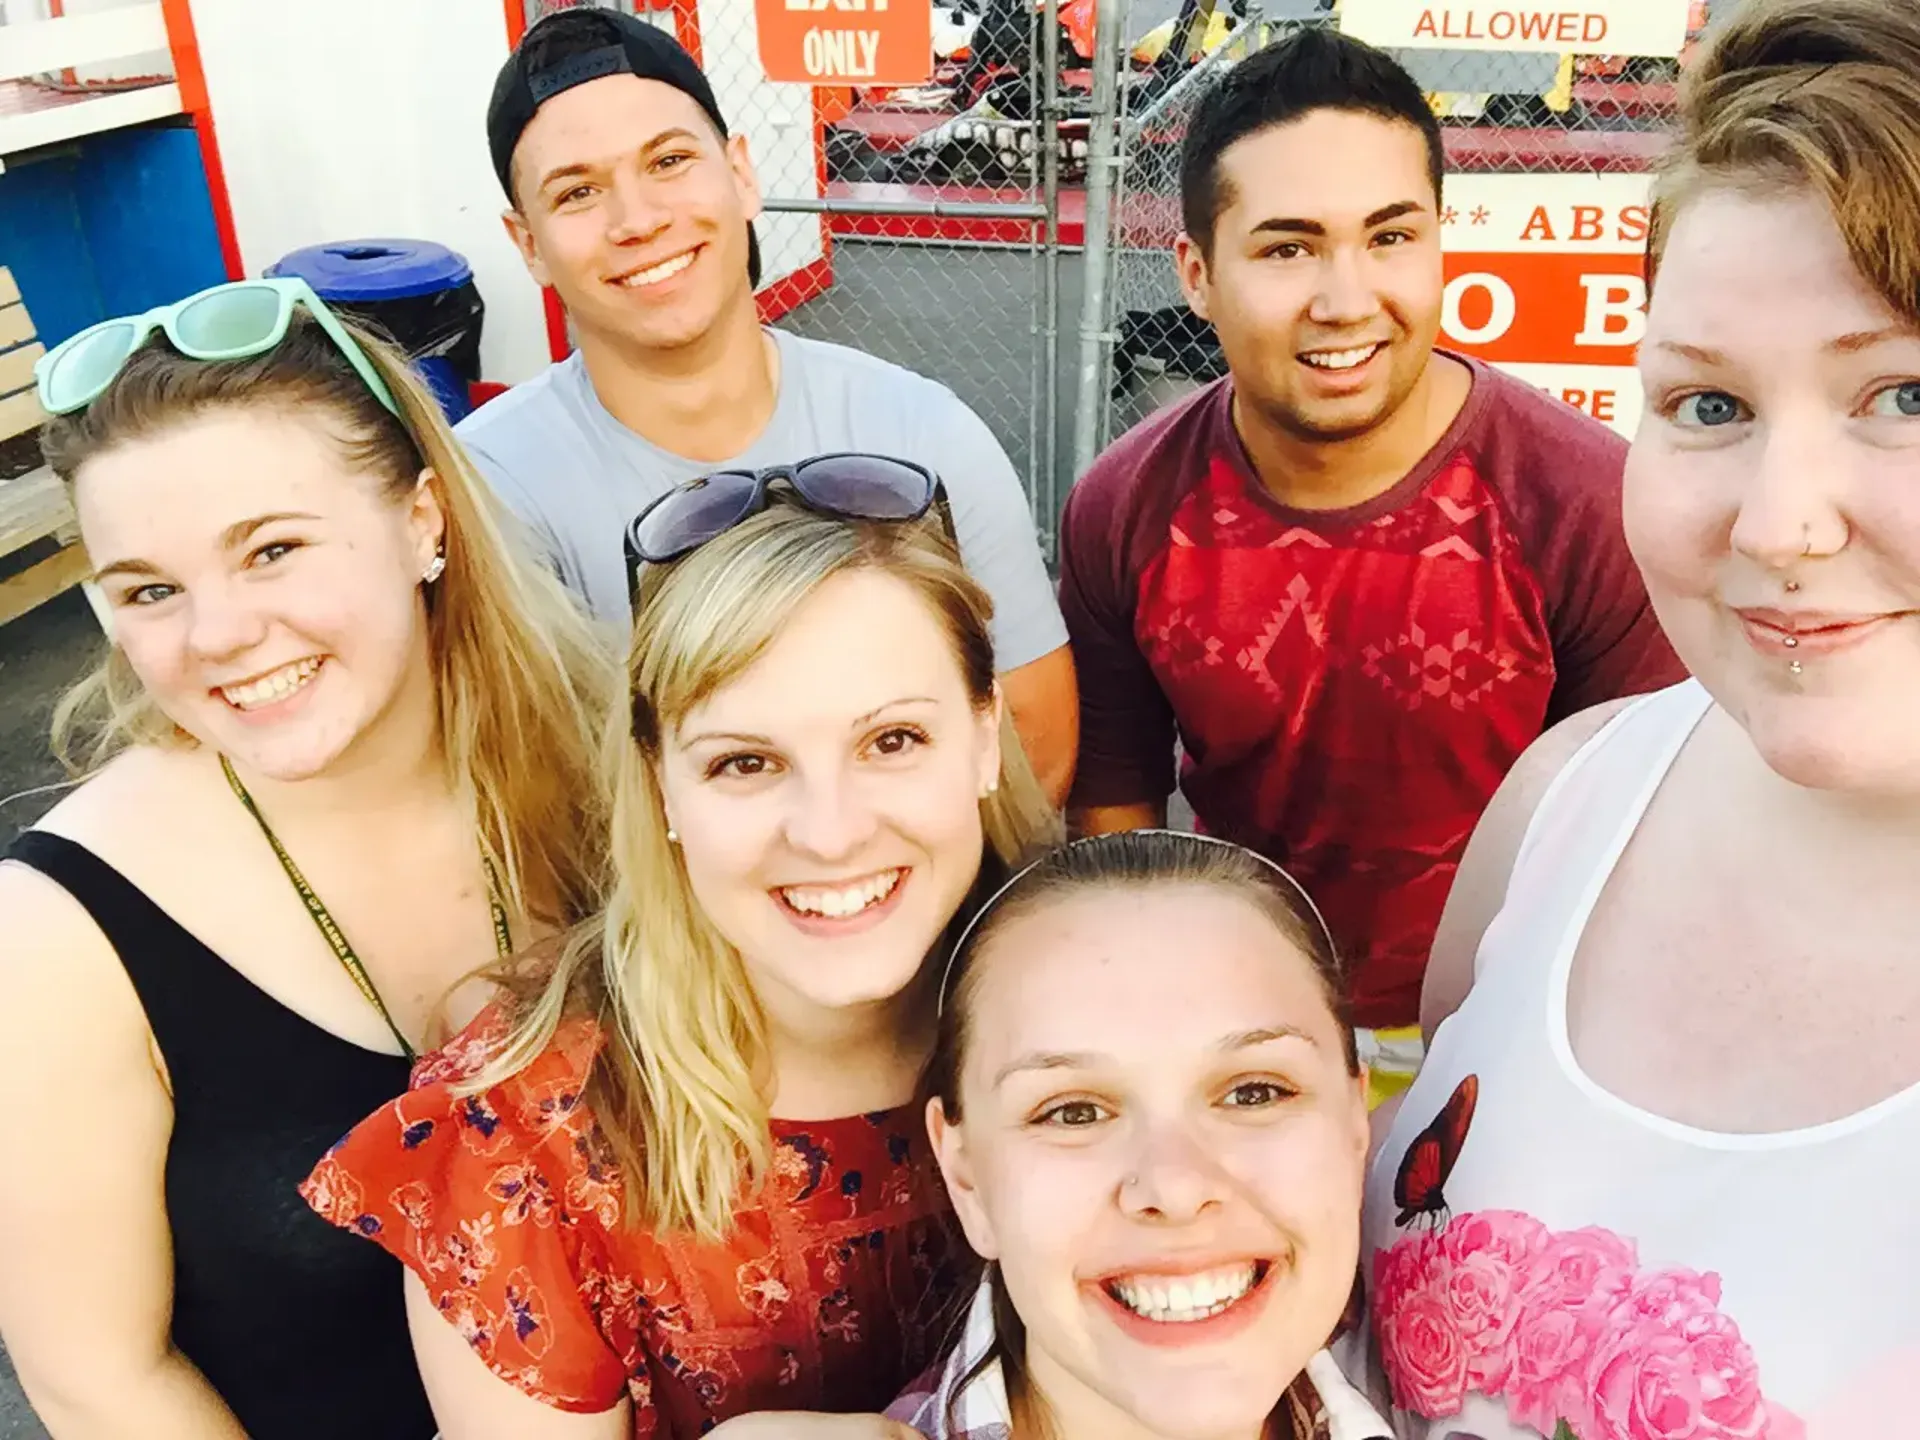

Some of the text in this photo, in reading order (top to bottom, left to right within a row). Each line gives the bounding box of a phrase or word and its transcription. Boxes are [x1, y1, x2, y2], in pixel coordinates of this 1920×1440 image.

[1413, 9, 1608, 42] ALLOWED
[803, 26, 880, 76] ONLY
[1519, 205, 1649, 241] ABS
